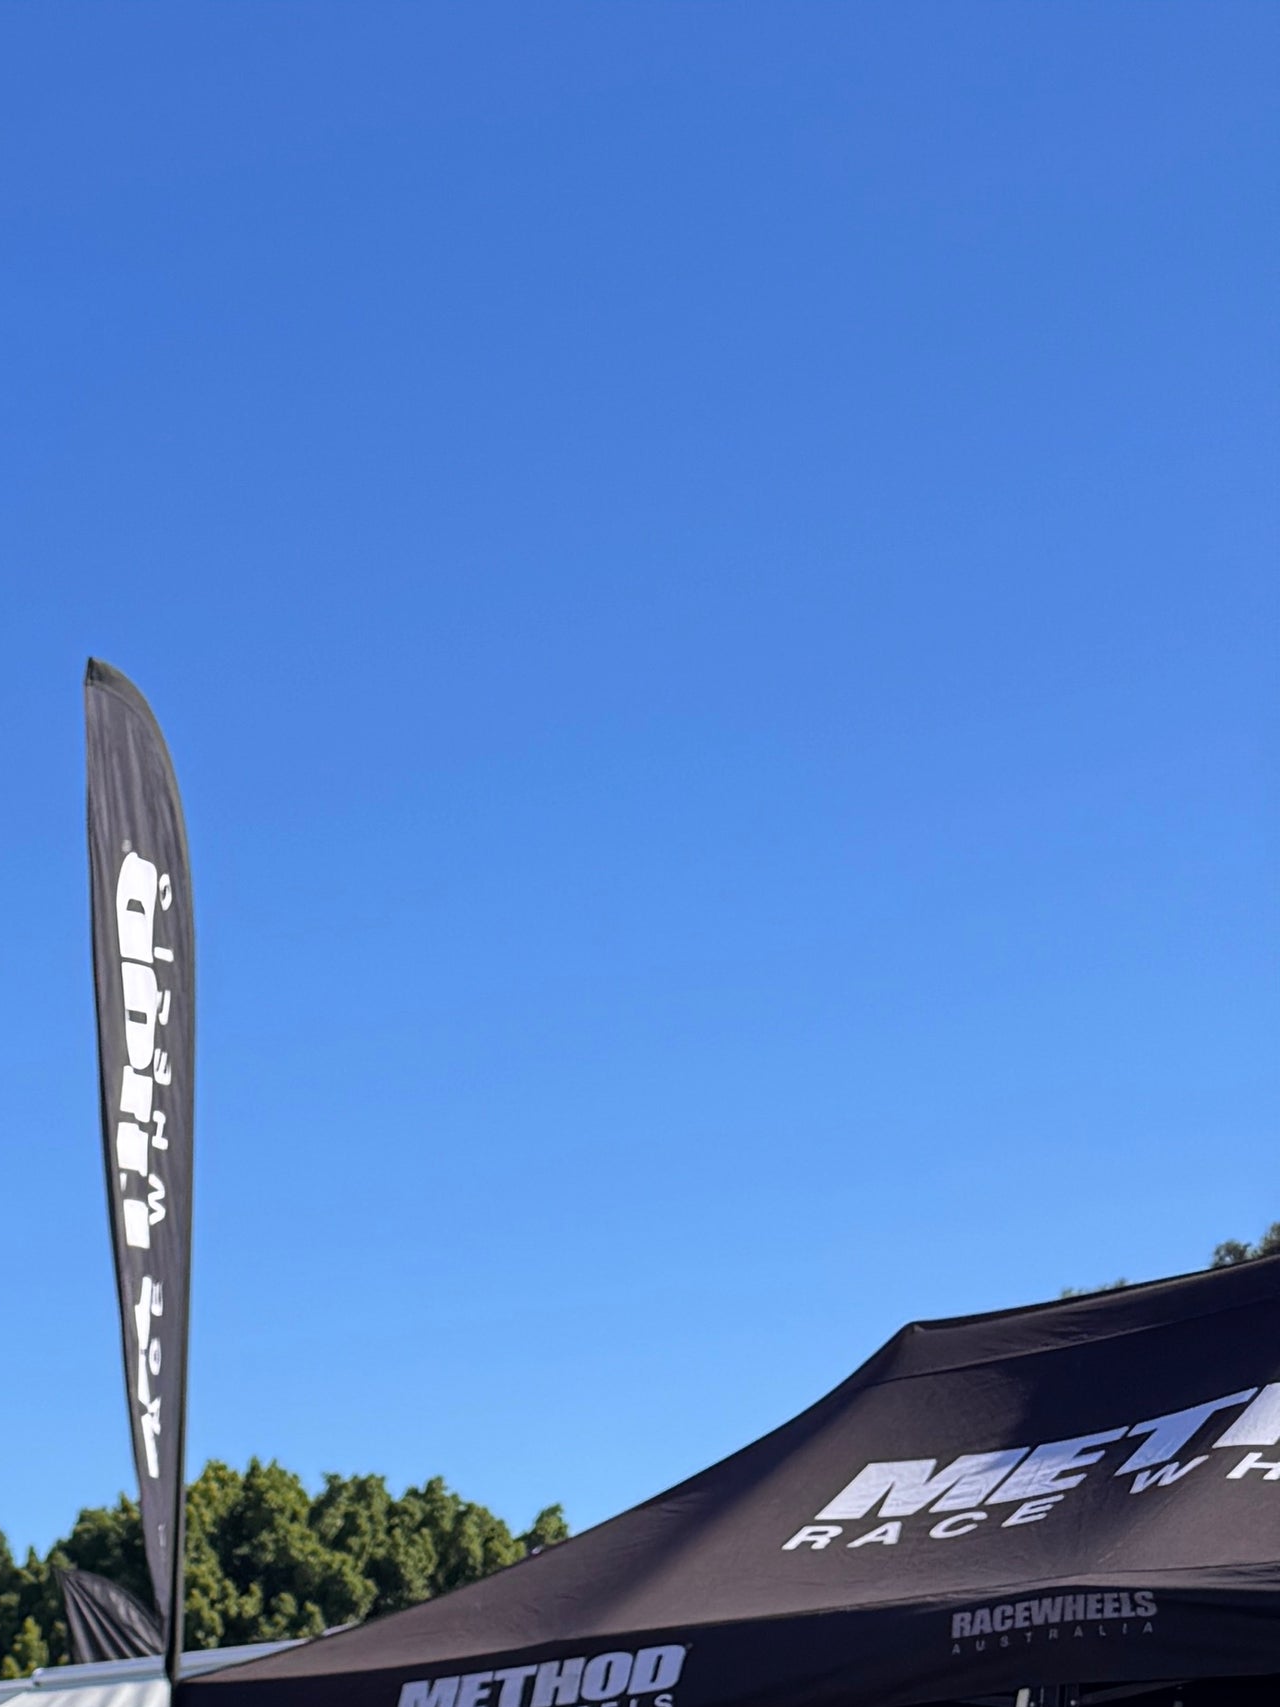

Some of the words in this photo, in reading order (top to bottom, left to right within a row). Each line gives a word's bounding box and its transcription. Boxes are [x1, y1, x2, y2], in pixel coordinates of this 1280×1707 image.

[781, 1494, 1065, 1552] RACE
[950, 1590, 1158, 1640] RACEWHEELS
[951, 1621, 1154, 1656] AUSTRALIA
